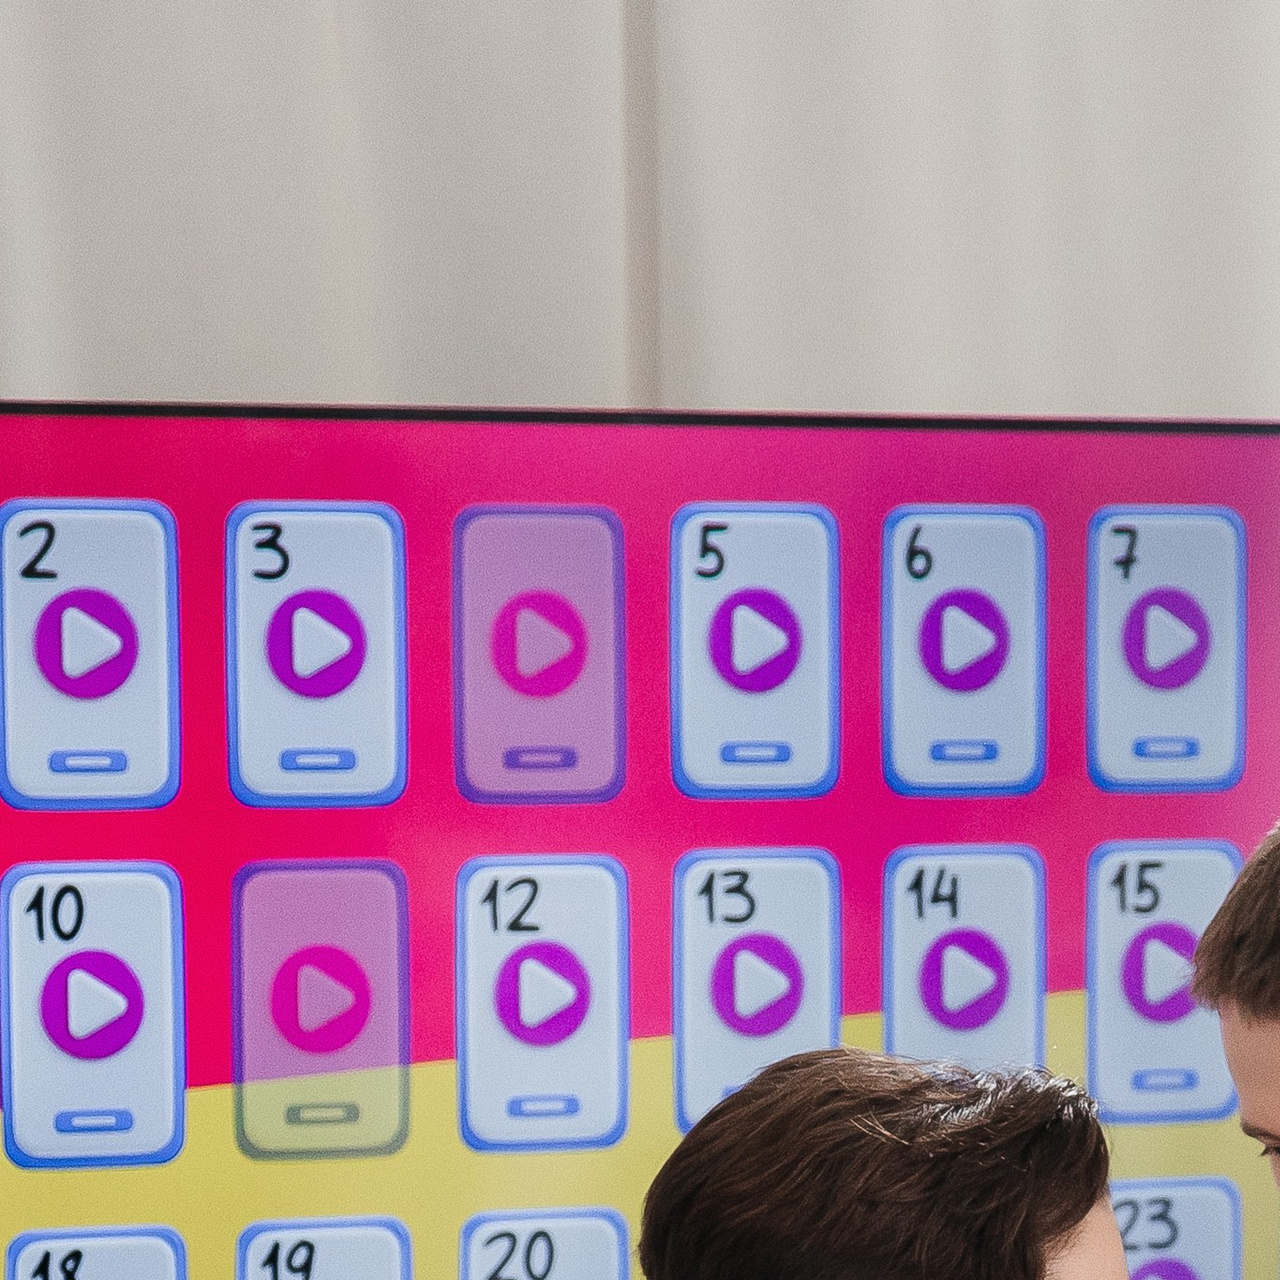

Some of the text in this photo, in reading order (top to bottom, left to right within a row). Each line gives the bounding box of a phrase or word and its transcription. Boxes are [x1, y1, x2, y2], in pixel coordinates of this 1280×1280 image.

[18, 519, 59, 581] 2
[250, 521, 292, 582] 3
[694, 522, 731, 580] 5
[903, 525, 935, 582] 6
[1109, 525, 1140, 581] 7
[24, 883, 86, 943] 10
[479, 875, 542, 934] 12
[696, 868, 757, 925] 13
[905, 866, 960, 920] 14
[1109, 860, 1165, 915] 15
[1113, 1198, 1179, 1251] 23
